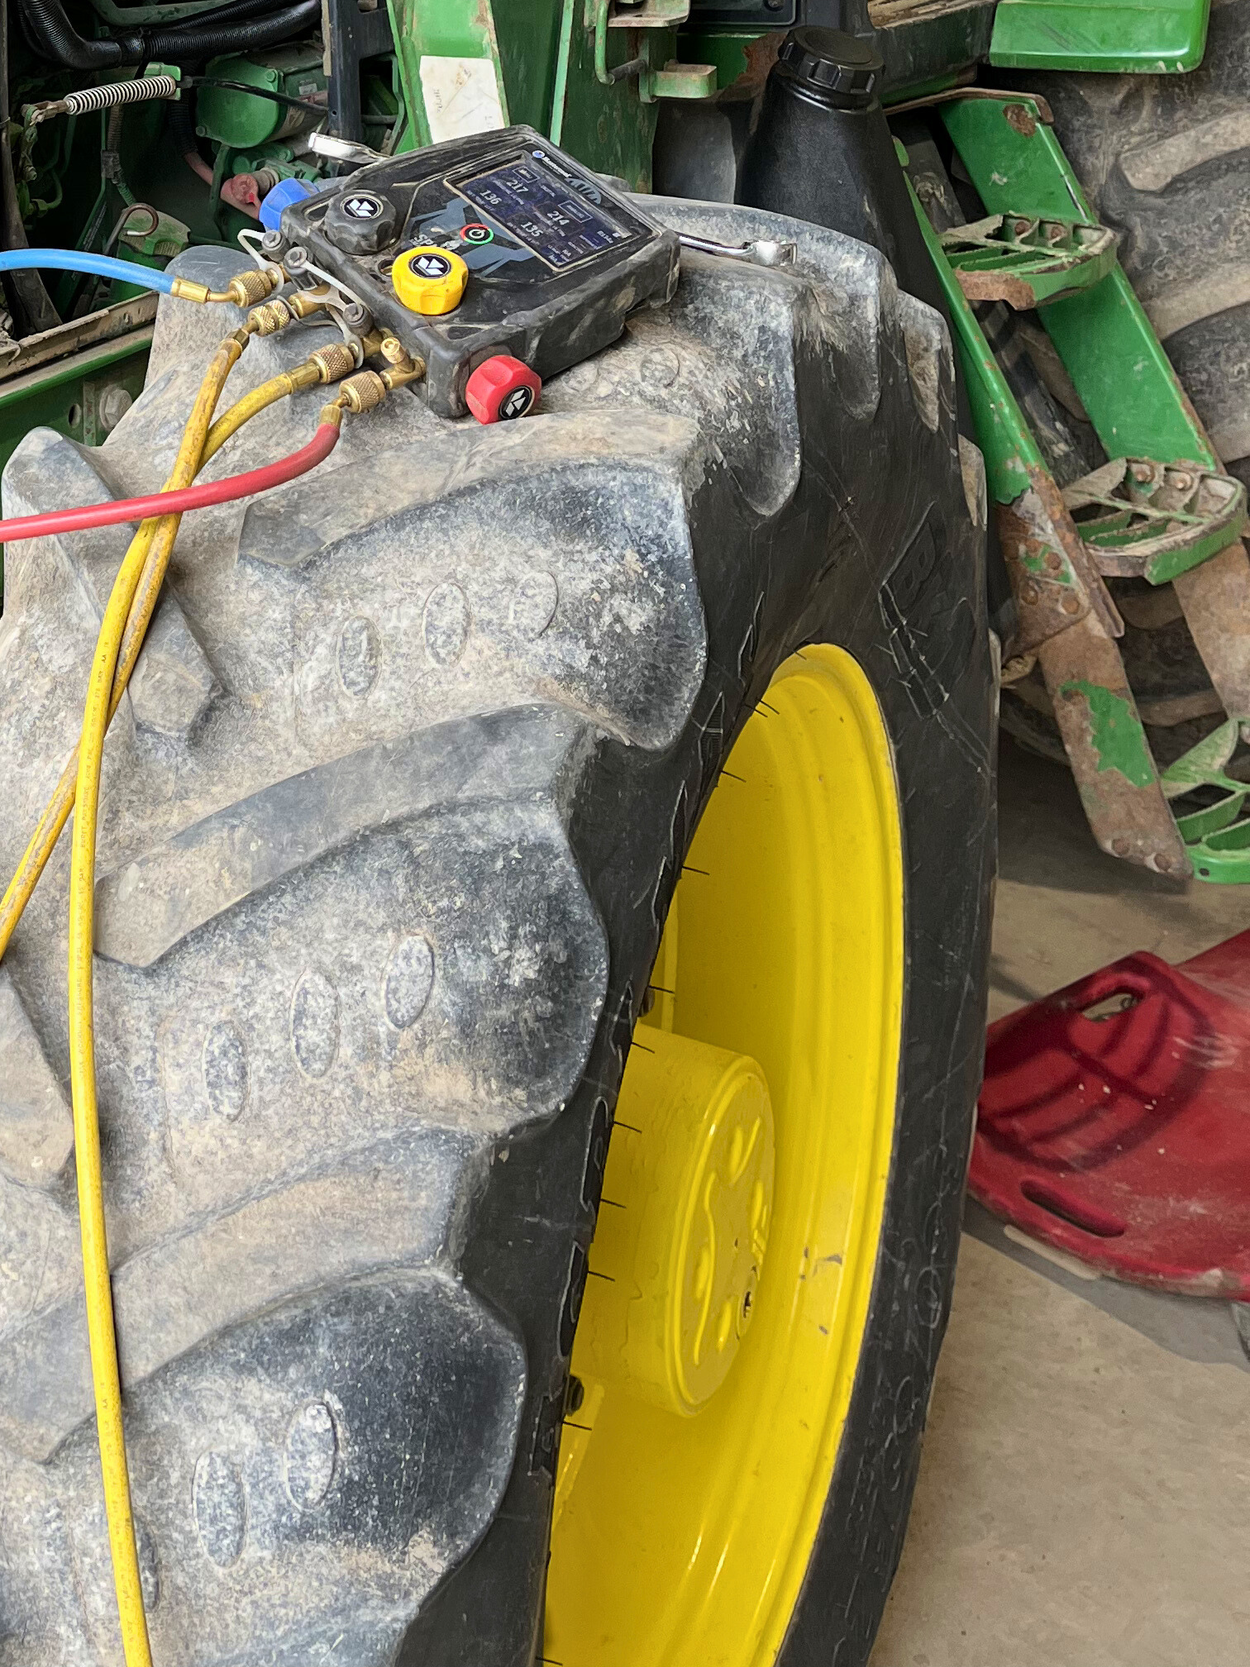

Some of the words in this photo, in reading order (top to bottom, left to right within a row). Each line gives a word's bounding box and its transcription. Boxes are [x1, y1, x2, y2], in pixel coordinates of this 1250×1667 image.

[506, 178, 529, 194] 217
[480, 188, 502, 206] 136
[546, 210, 570, 227] 214
[520, 220, 544, 238] 135
